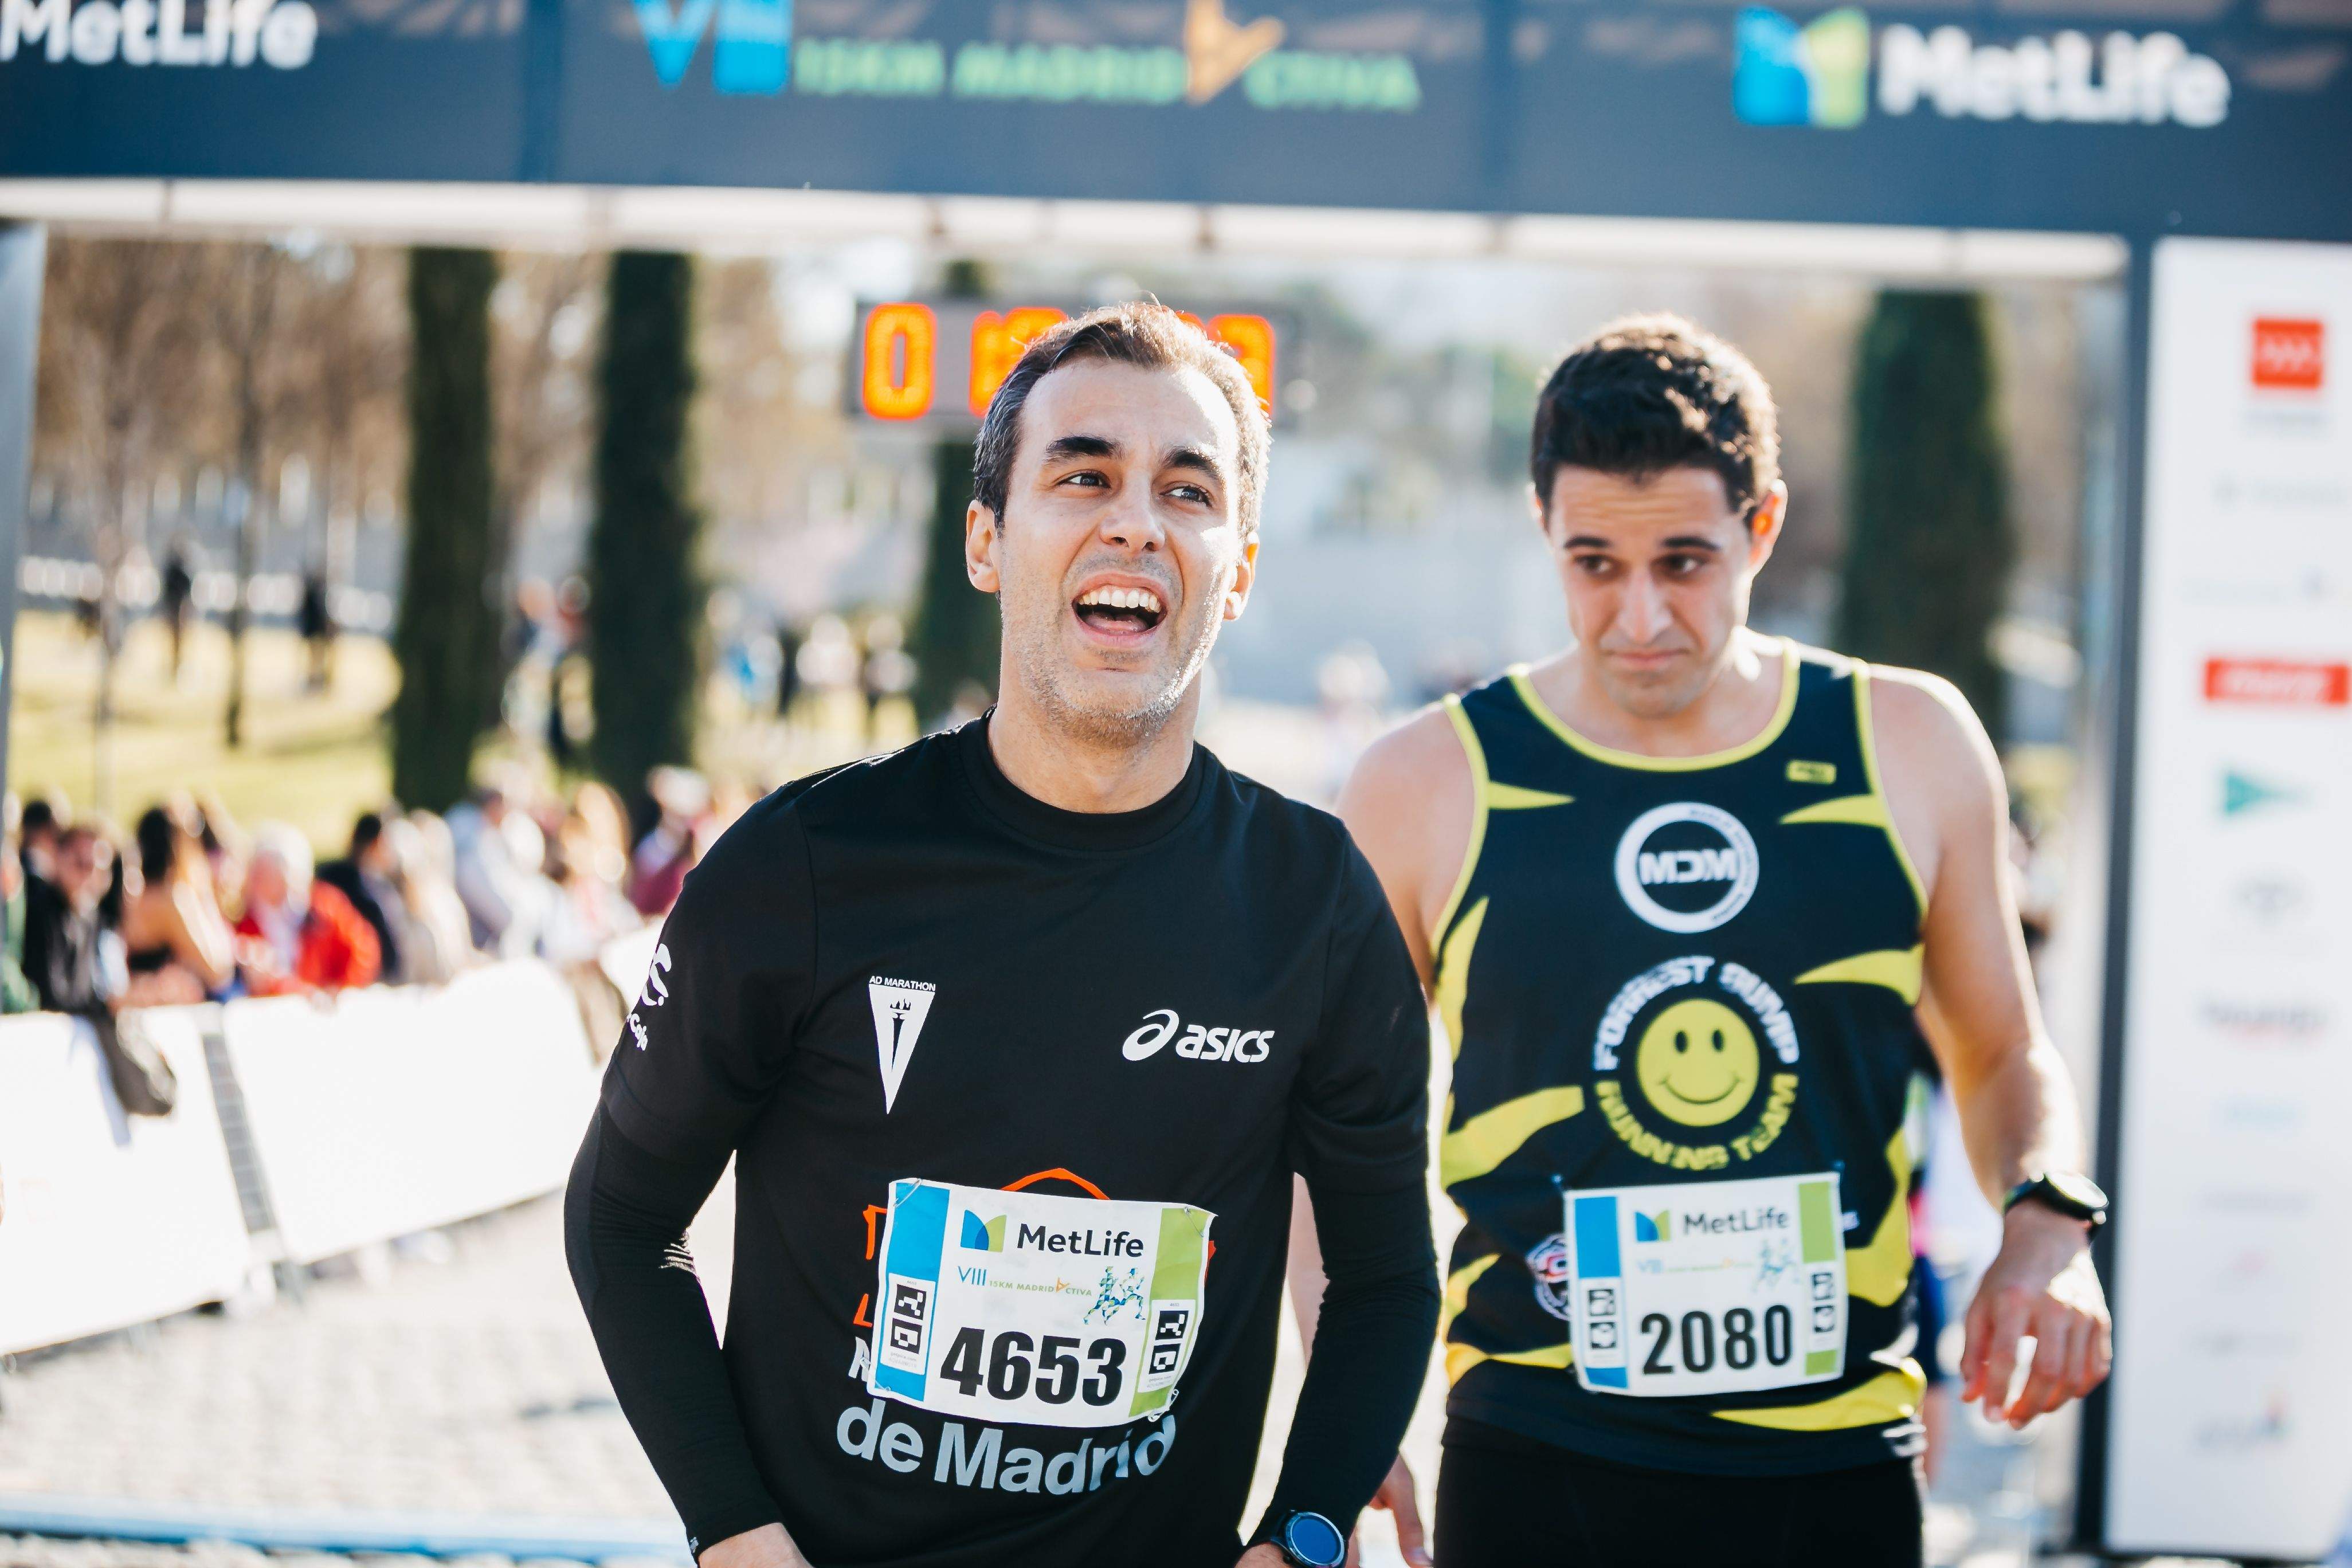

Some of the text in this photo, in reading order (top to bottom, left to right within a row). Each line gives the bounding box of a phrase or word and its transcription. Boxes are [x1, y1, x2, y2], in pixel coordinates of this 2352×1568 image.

[1877, 23, 2231, 126] MetLife
[869, 975, 936, 991] AD MARATHON
[1175, 1024, 1275, 1063] asics
[1017, 1223, 1144, 1257] MetLife
[1684, 1206, 1789, 1236] MetLife
[957, 1265, 987, 1286] VIII
[989, 1280, 1013, 1289] 15KM
[1016, 1283, 1055, 1293] MADRID
[1640, 1304, 1792, 1377] 2080
[940, 1327, 1127, 1406] 4653
[837, 1399, 1176, 1495] de Madrid
